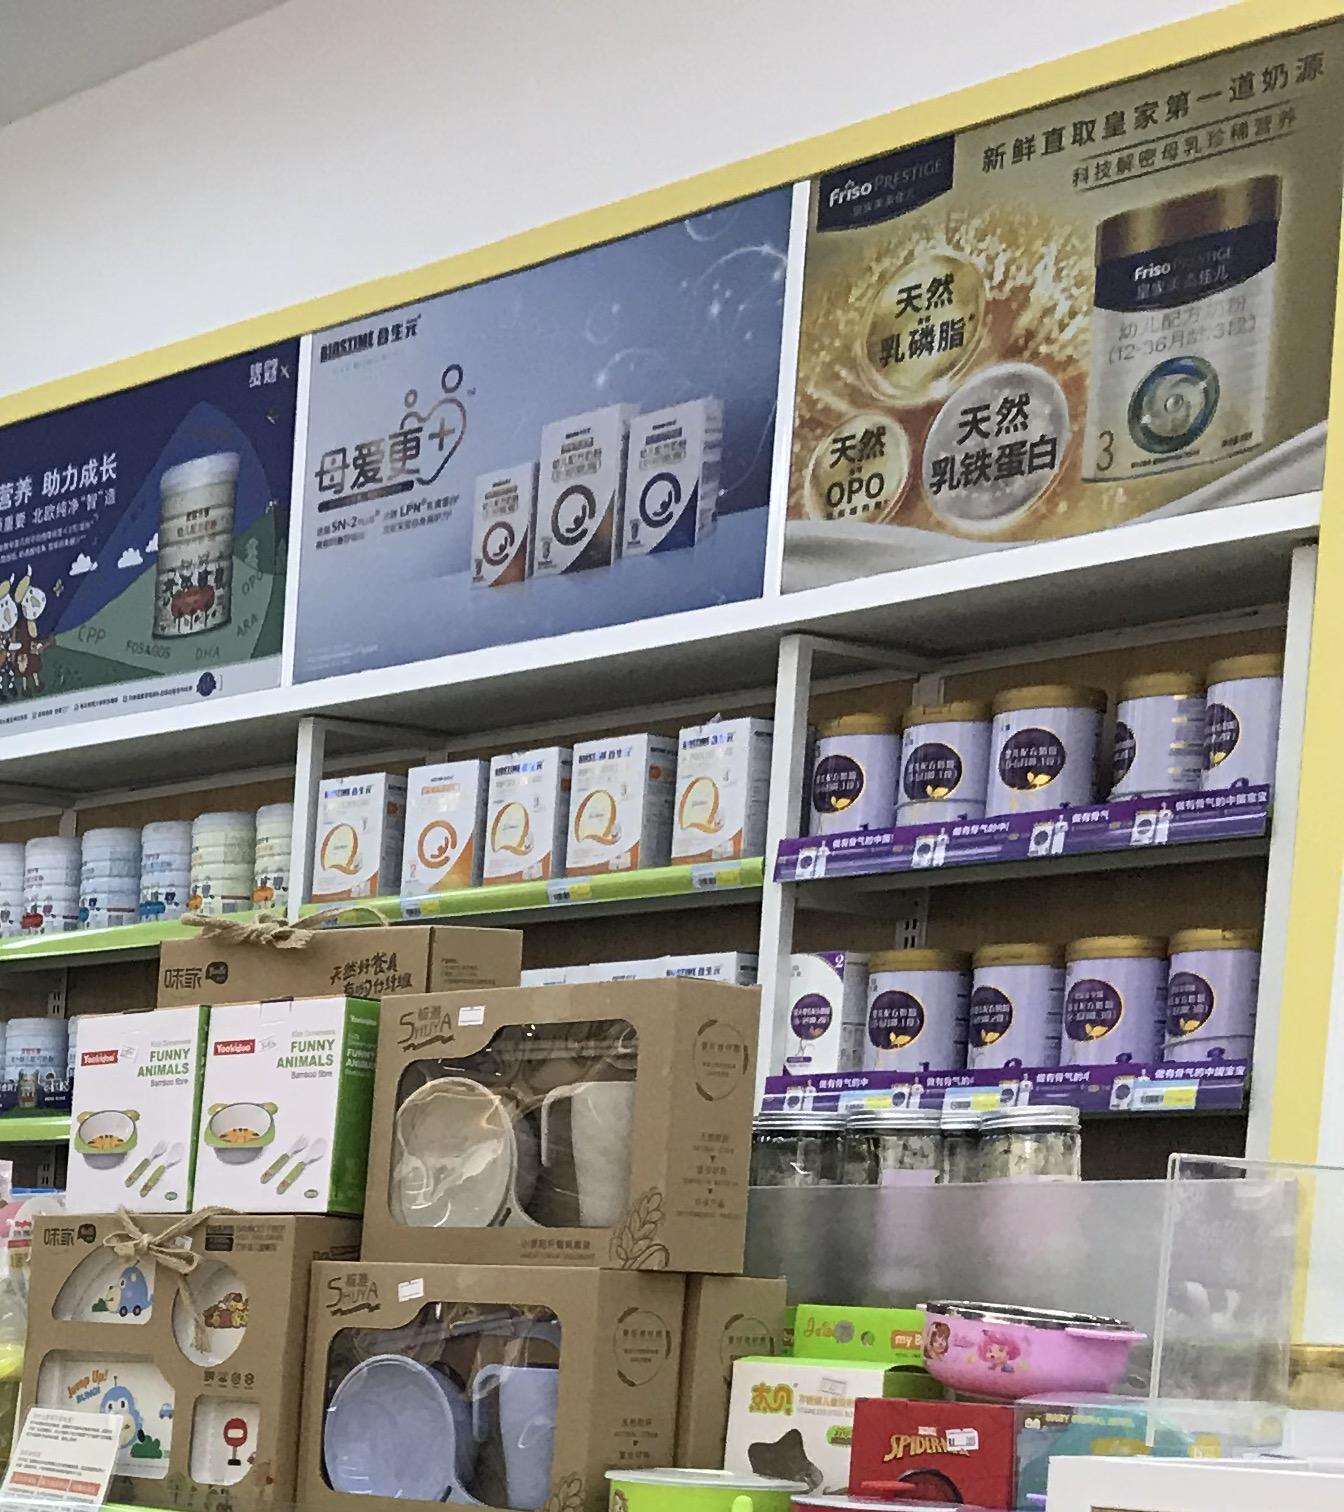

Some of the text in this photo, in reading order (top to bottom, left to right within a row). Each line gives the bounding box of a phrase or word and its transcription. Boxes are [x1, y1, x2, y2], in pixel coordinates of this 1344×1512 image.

[981, 51, 1326, 174] 新鲜直取皇家第一道奶源
[828, 179, 873, 207] Friso
[1134, 261, 1171, 281] Friso
[895, 273, 955, 319] 天然
[879, 315, 967, 368] 乳磷脂
[958, 392, 1031, 445] 天然
[829, 427, 886, 468] 天然
[42, 452, 118, 497] 助力成长
[930, 433, 1059, 495] 乳铁蛋白
[826, 471, 885, 508] OPO
[164, 965, 202, 989] 味家
[330, 951, 399, 986] 天然好餐具
[149, 1047, 191, 1063] FUNNY
[276, 1053, 334, 1069] ANIMALS
[290, 1038, 334, 1054] FUNNY
[137, 1060, 190, 1077] ANIMALS
[44, 1226, 75, 1247] 味家
[895, 1335, 911, 1348] my
